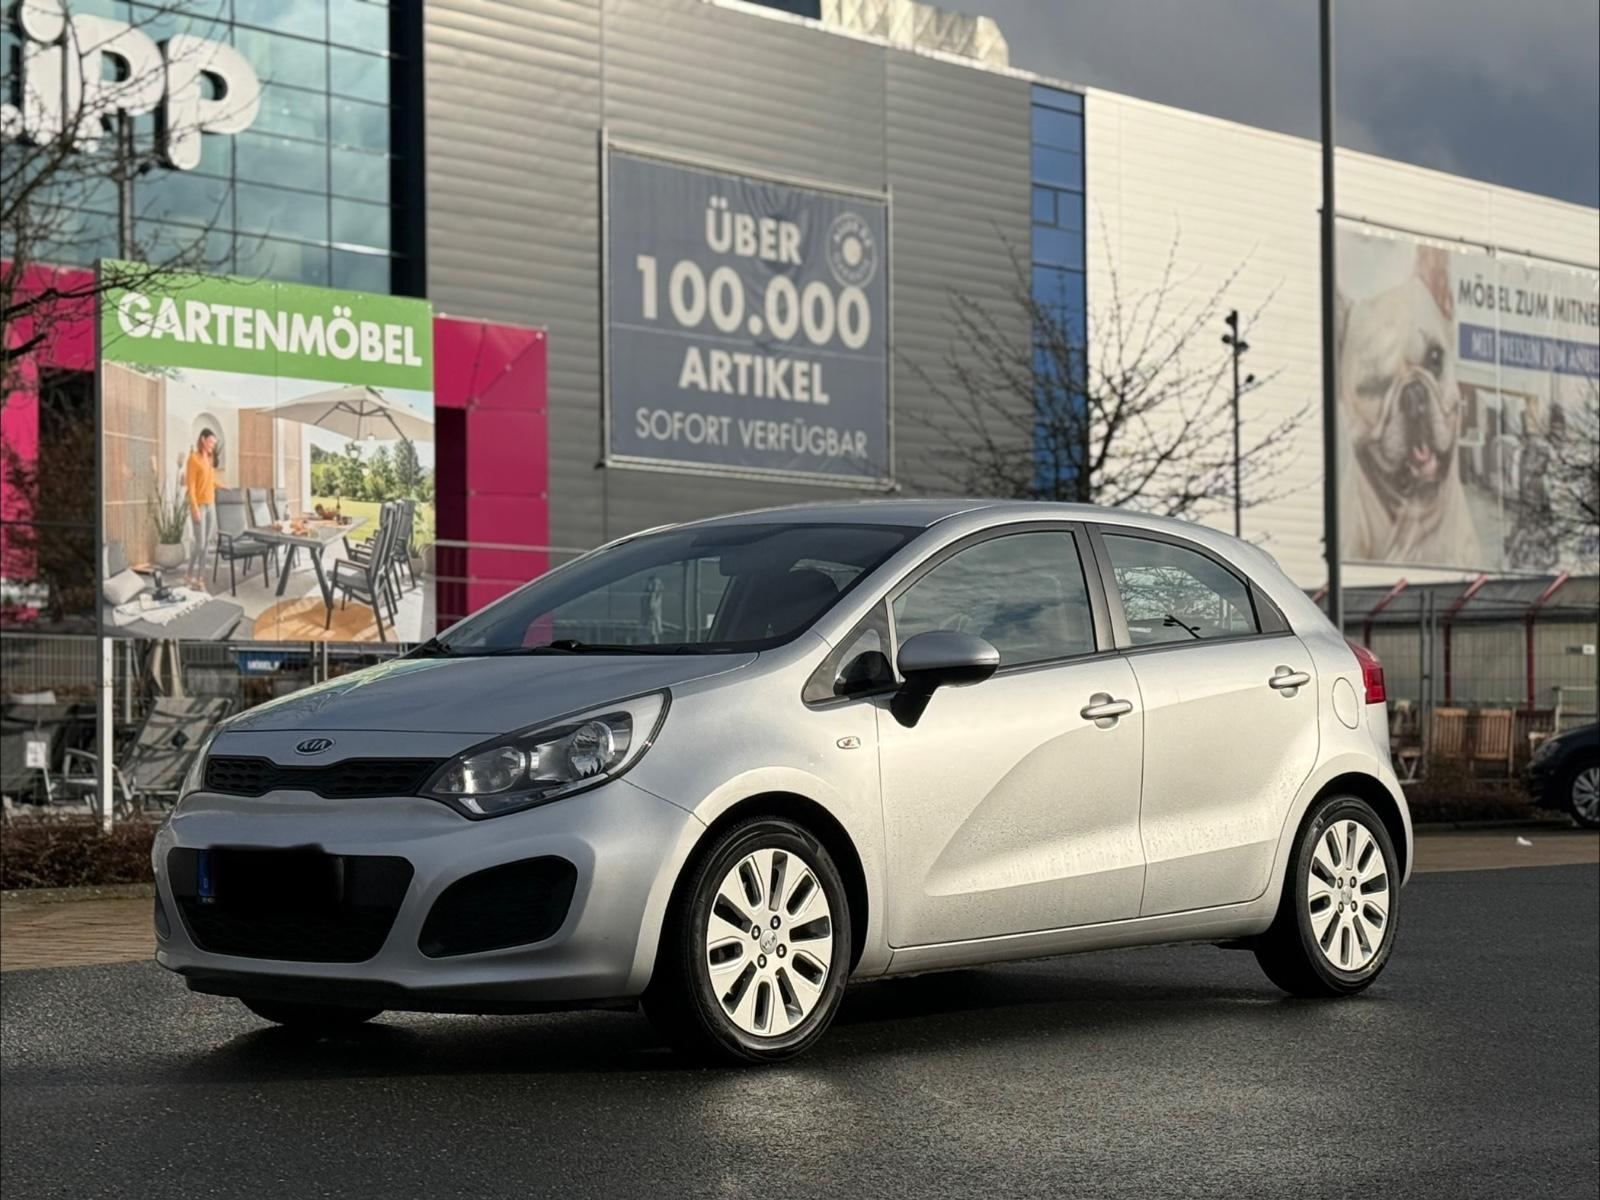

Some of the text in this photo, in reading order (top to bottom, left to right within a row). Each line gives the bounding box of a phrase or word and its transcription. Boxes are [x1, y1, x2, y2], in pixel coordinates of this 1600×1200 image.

[706, 195, 803, 265] ÜBER
[637, 254, 870, 350] 100.000
[1458, 274, 1511, 313] MÖBEL
[1516, 289, 1549, 319] ZUM
[117, 291, 423, 368] GARTENMÖBEL
[678, 346, 830, 405] ARTIKEL
[635, 407, 868, 459] SOFORT VERFÜGBAR
[298, 739, 330, 751] KIA
